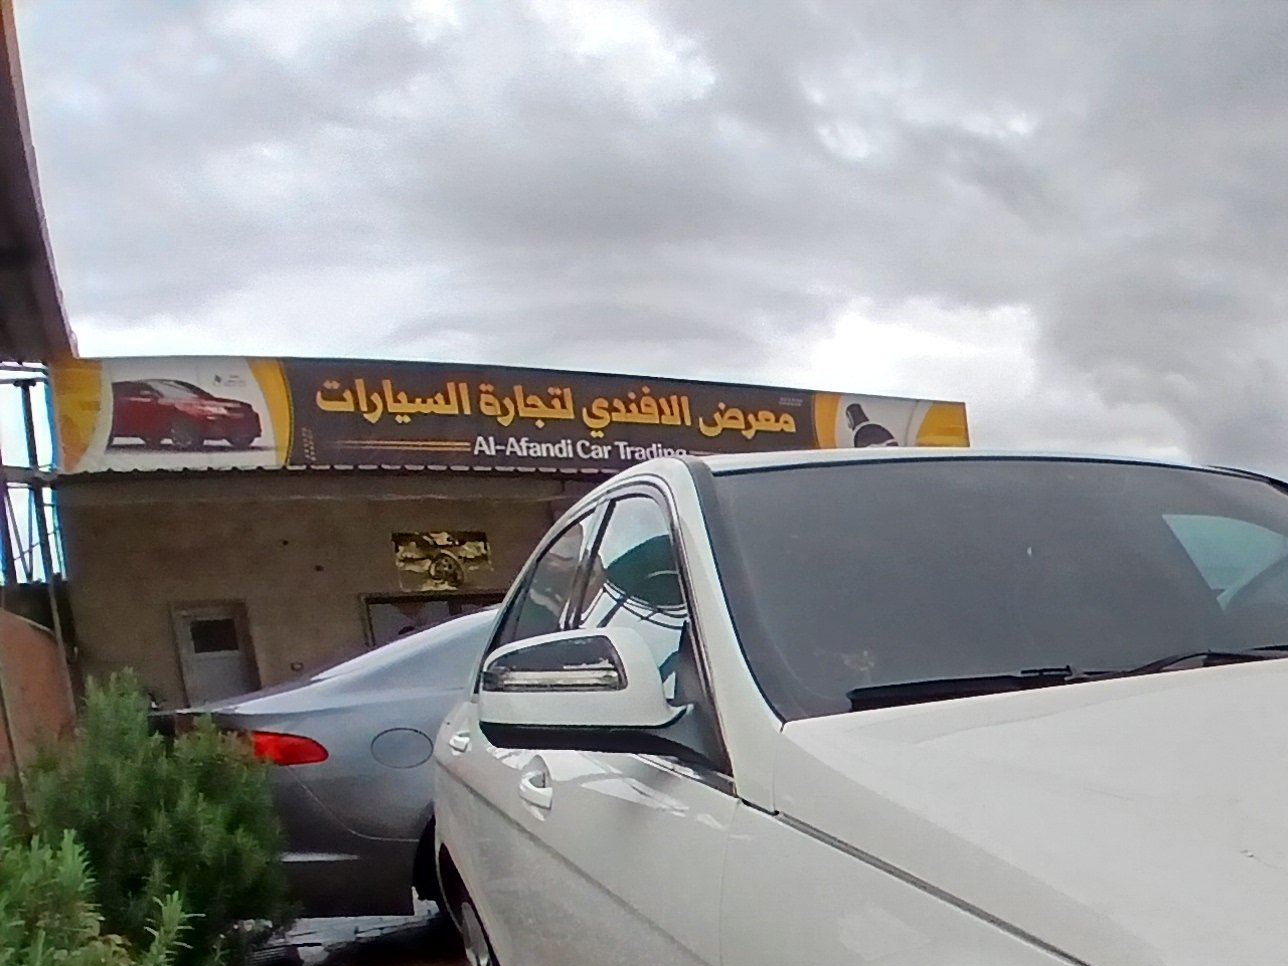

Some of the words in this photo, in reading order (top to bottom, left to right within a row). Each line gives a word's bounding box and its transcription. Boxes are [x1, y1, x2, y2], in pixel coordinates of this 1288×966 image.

[316, 378, 471, 424] السيارات
[479, 384, 575, 428] لتجارة
[582, 385, 692, 438] الافندي
[699, 402, 797, 440] معرض
[473, 436, 574, 458] Al-Afandi
[576, 439, 612, 460] Car
